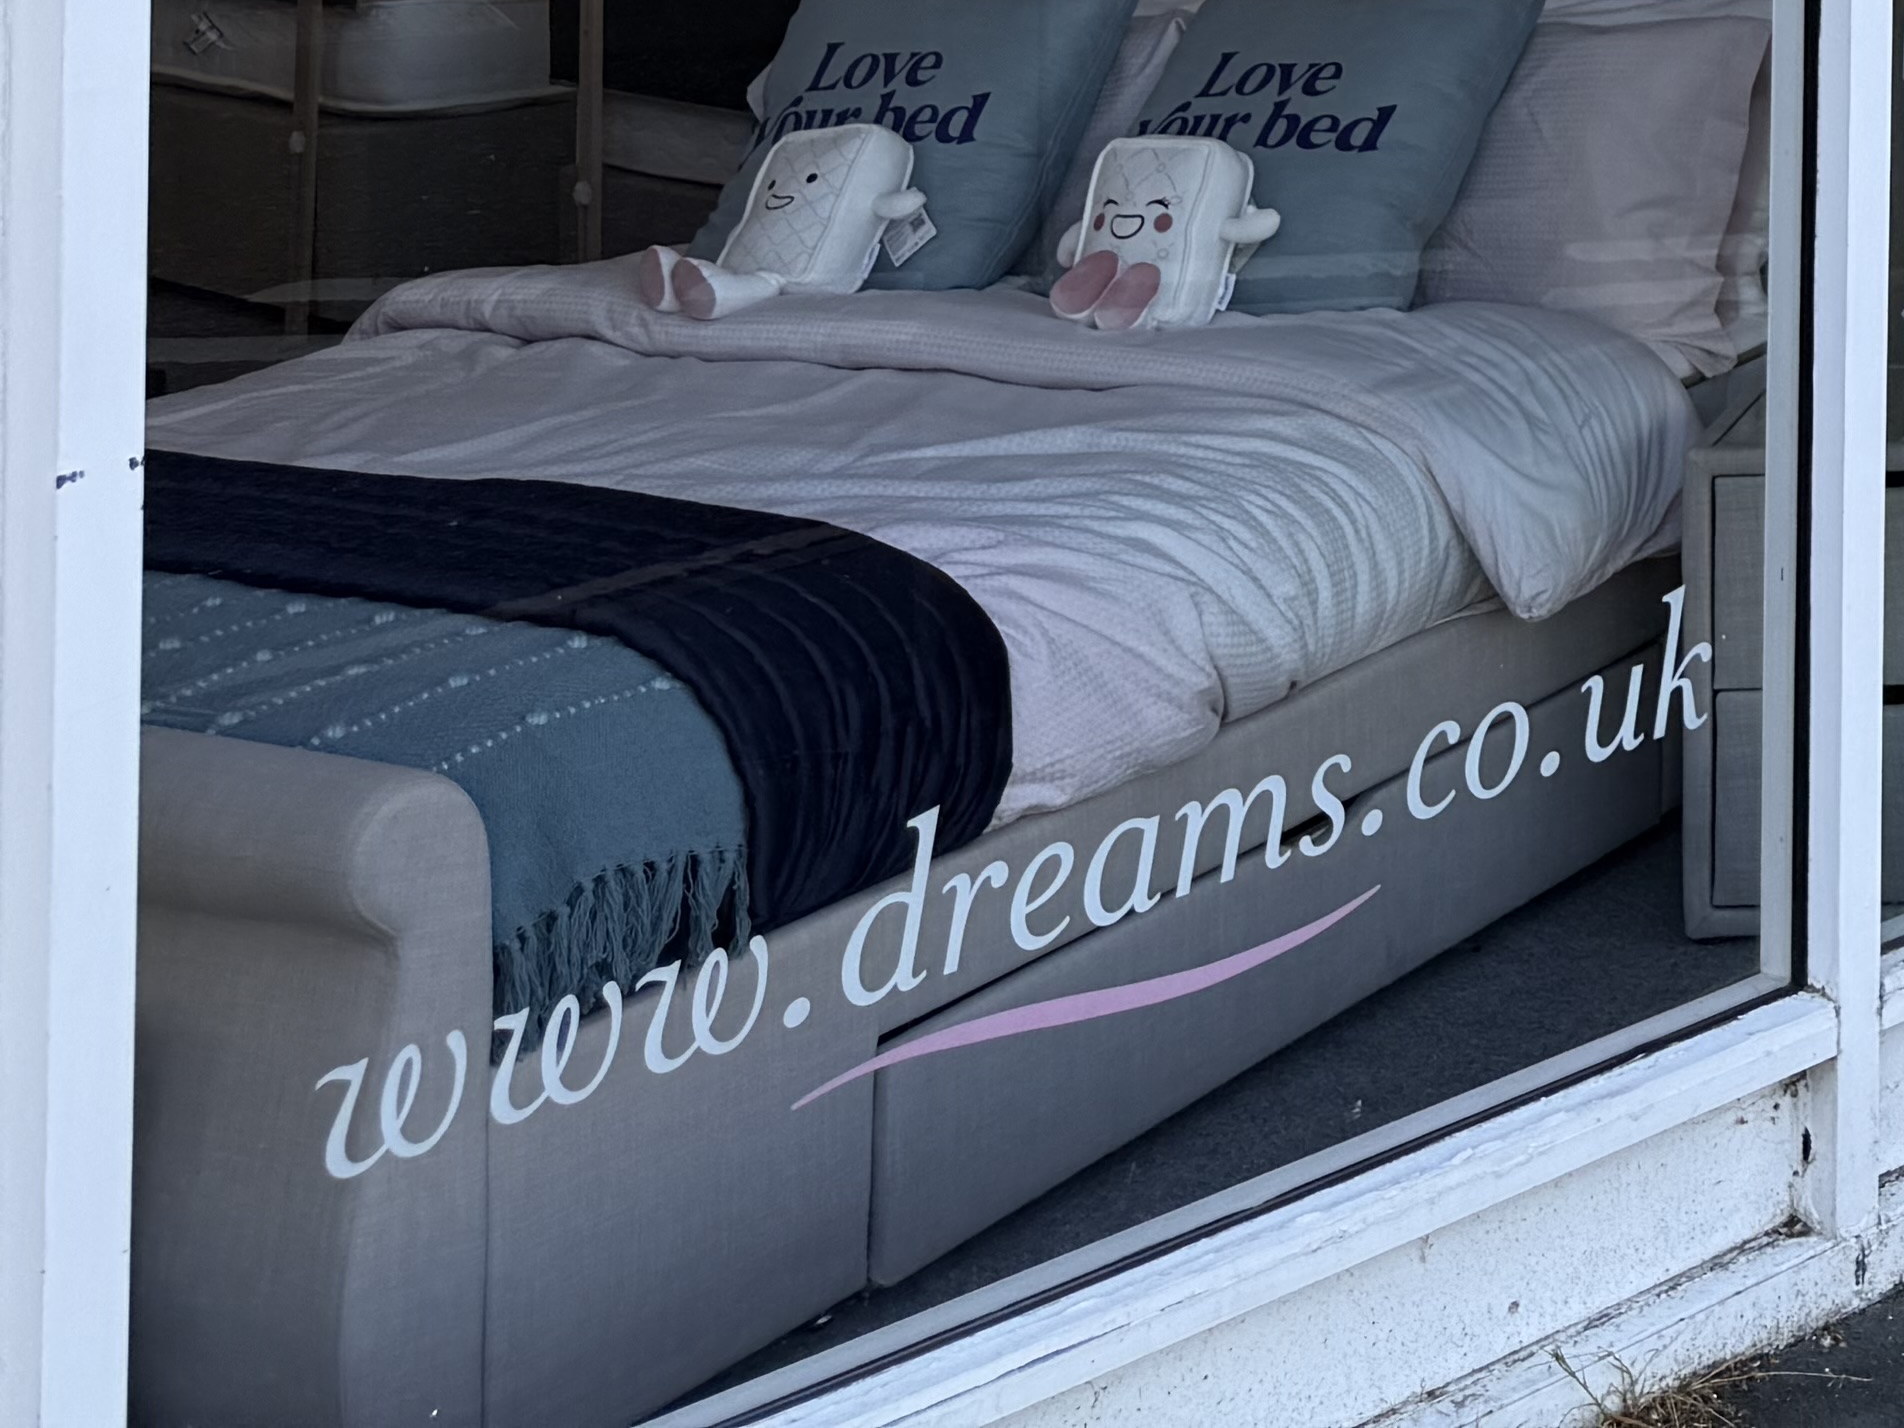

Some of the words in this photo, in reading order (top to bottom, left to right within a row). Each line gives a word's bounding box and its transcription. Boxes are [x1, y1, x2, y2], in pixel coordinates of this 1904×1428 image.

[805, 41, 943, 92] Love
[1195, 51, 1344, 101] Love
[1253, 97, 1399, 154] bed
[313, 584, 1713, 1181] www.dreams.co.uk
